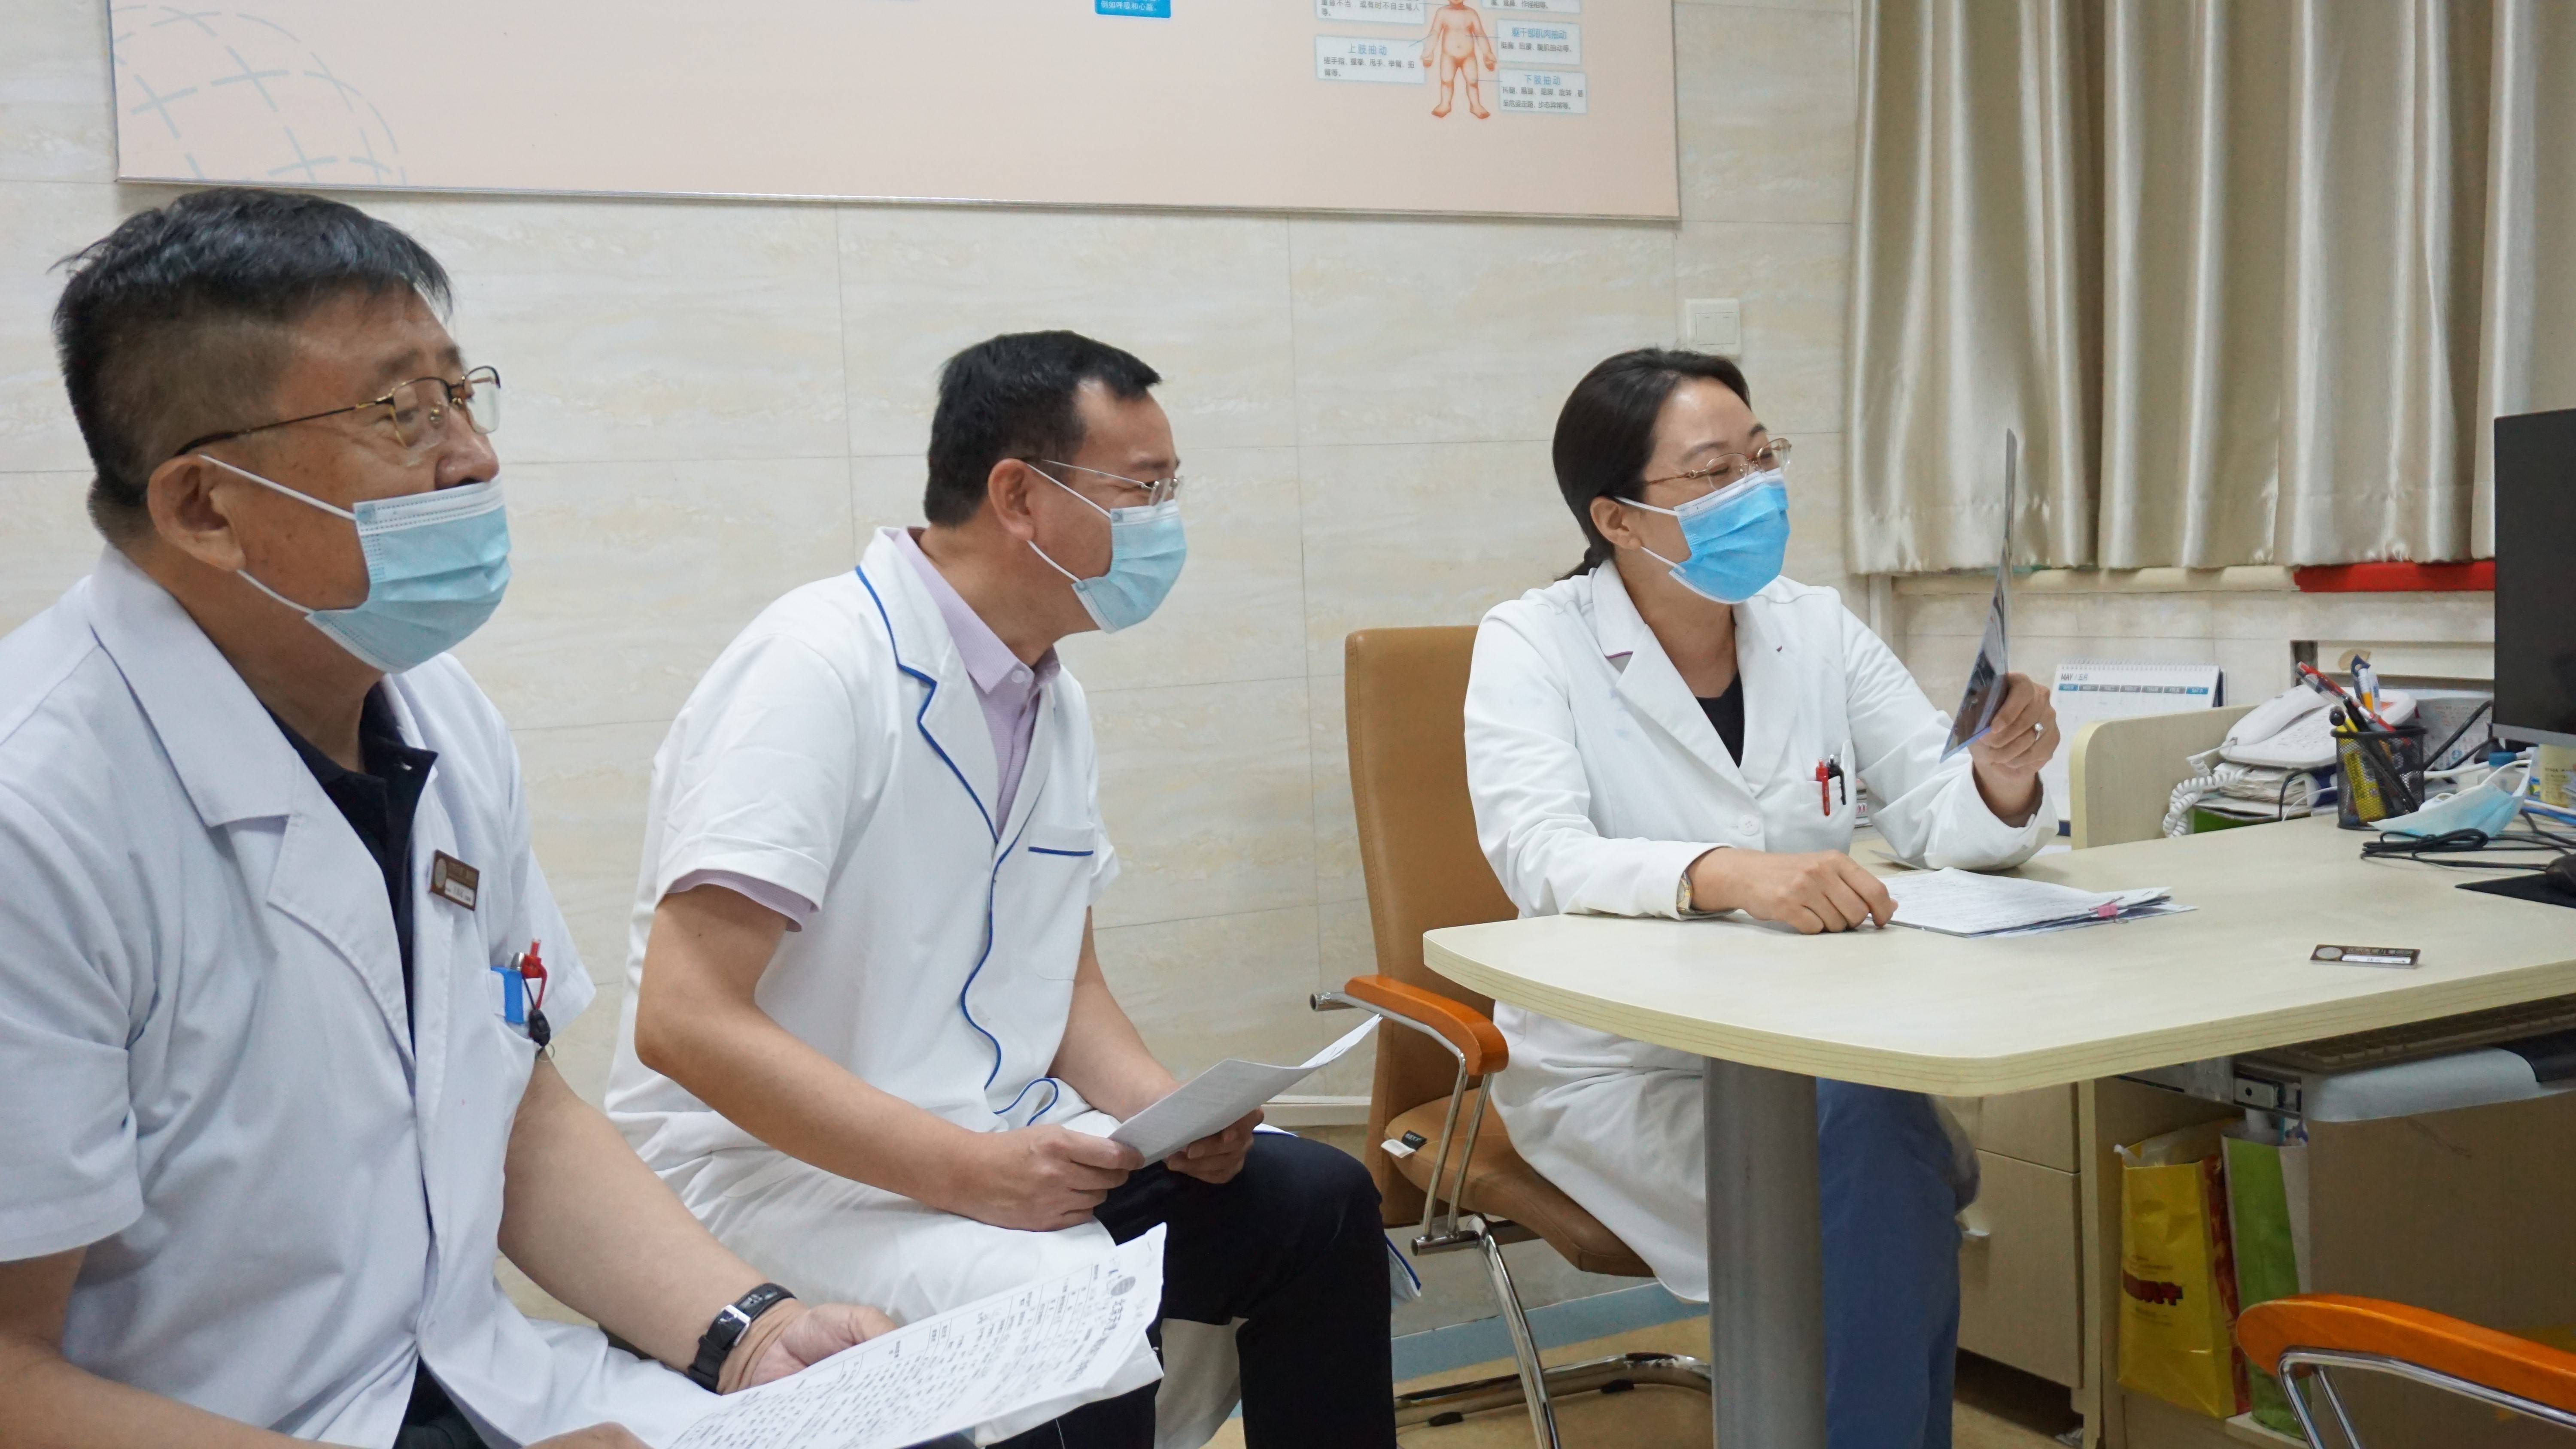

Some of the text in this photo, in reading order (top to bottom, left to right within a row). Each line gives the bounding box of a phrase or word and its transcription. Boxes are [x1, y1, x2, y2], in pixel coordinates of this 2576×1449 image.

[1511, 27, 1567, 39] 躯干部肌肉抽动
[1348, 43, 1388, 55] 上肢抽动
[1524, 74, 1561, 86] 下肢抽动
